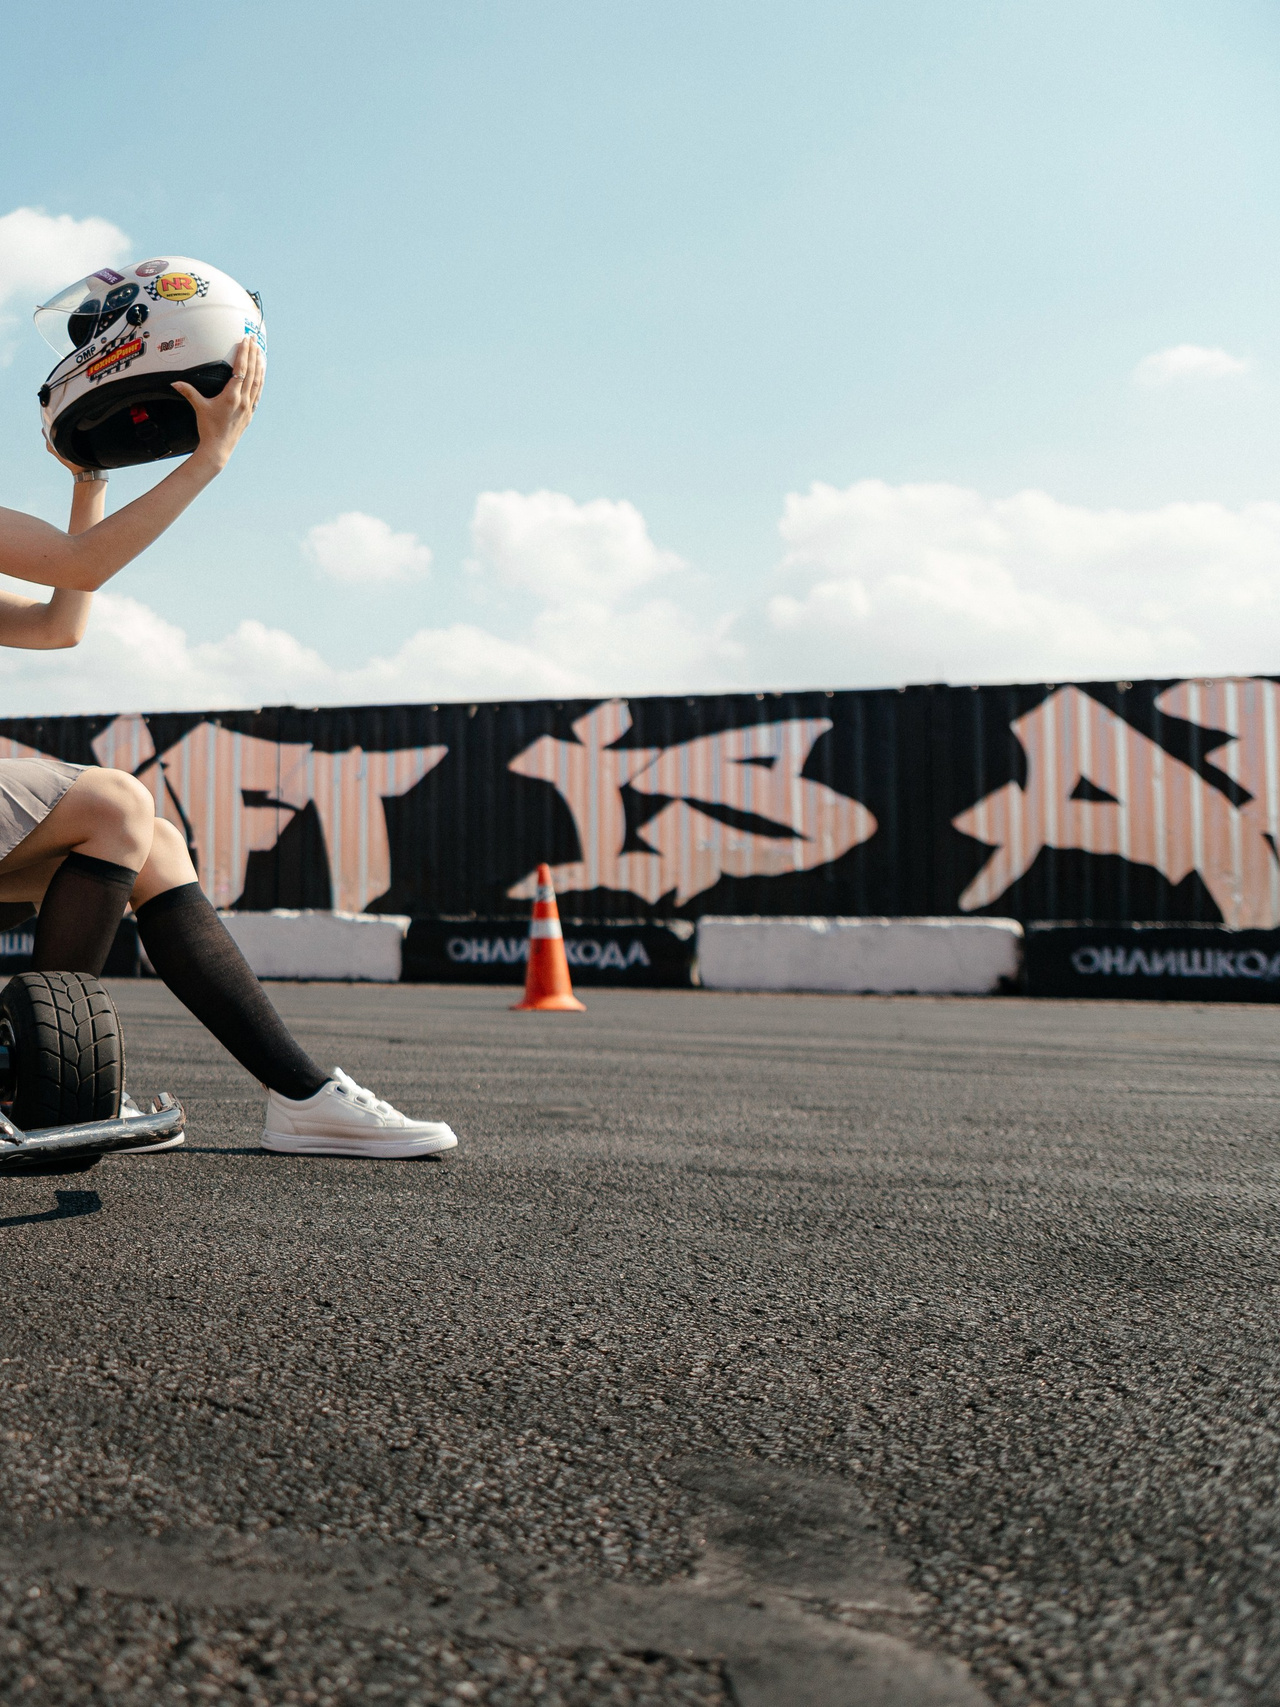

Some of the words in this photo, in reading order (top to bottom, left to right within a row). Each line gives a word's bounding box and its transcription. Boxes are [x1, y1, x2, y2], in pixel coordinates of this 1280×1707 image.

[161, 276, 194, 292] NR
[76, 346, 96, 363] OMP
[446, 937, 651, 969] ОНЛИКОДА
